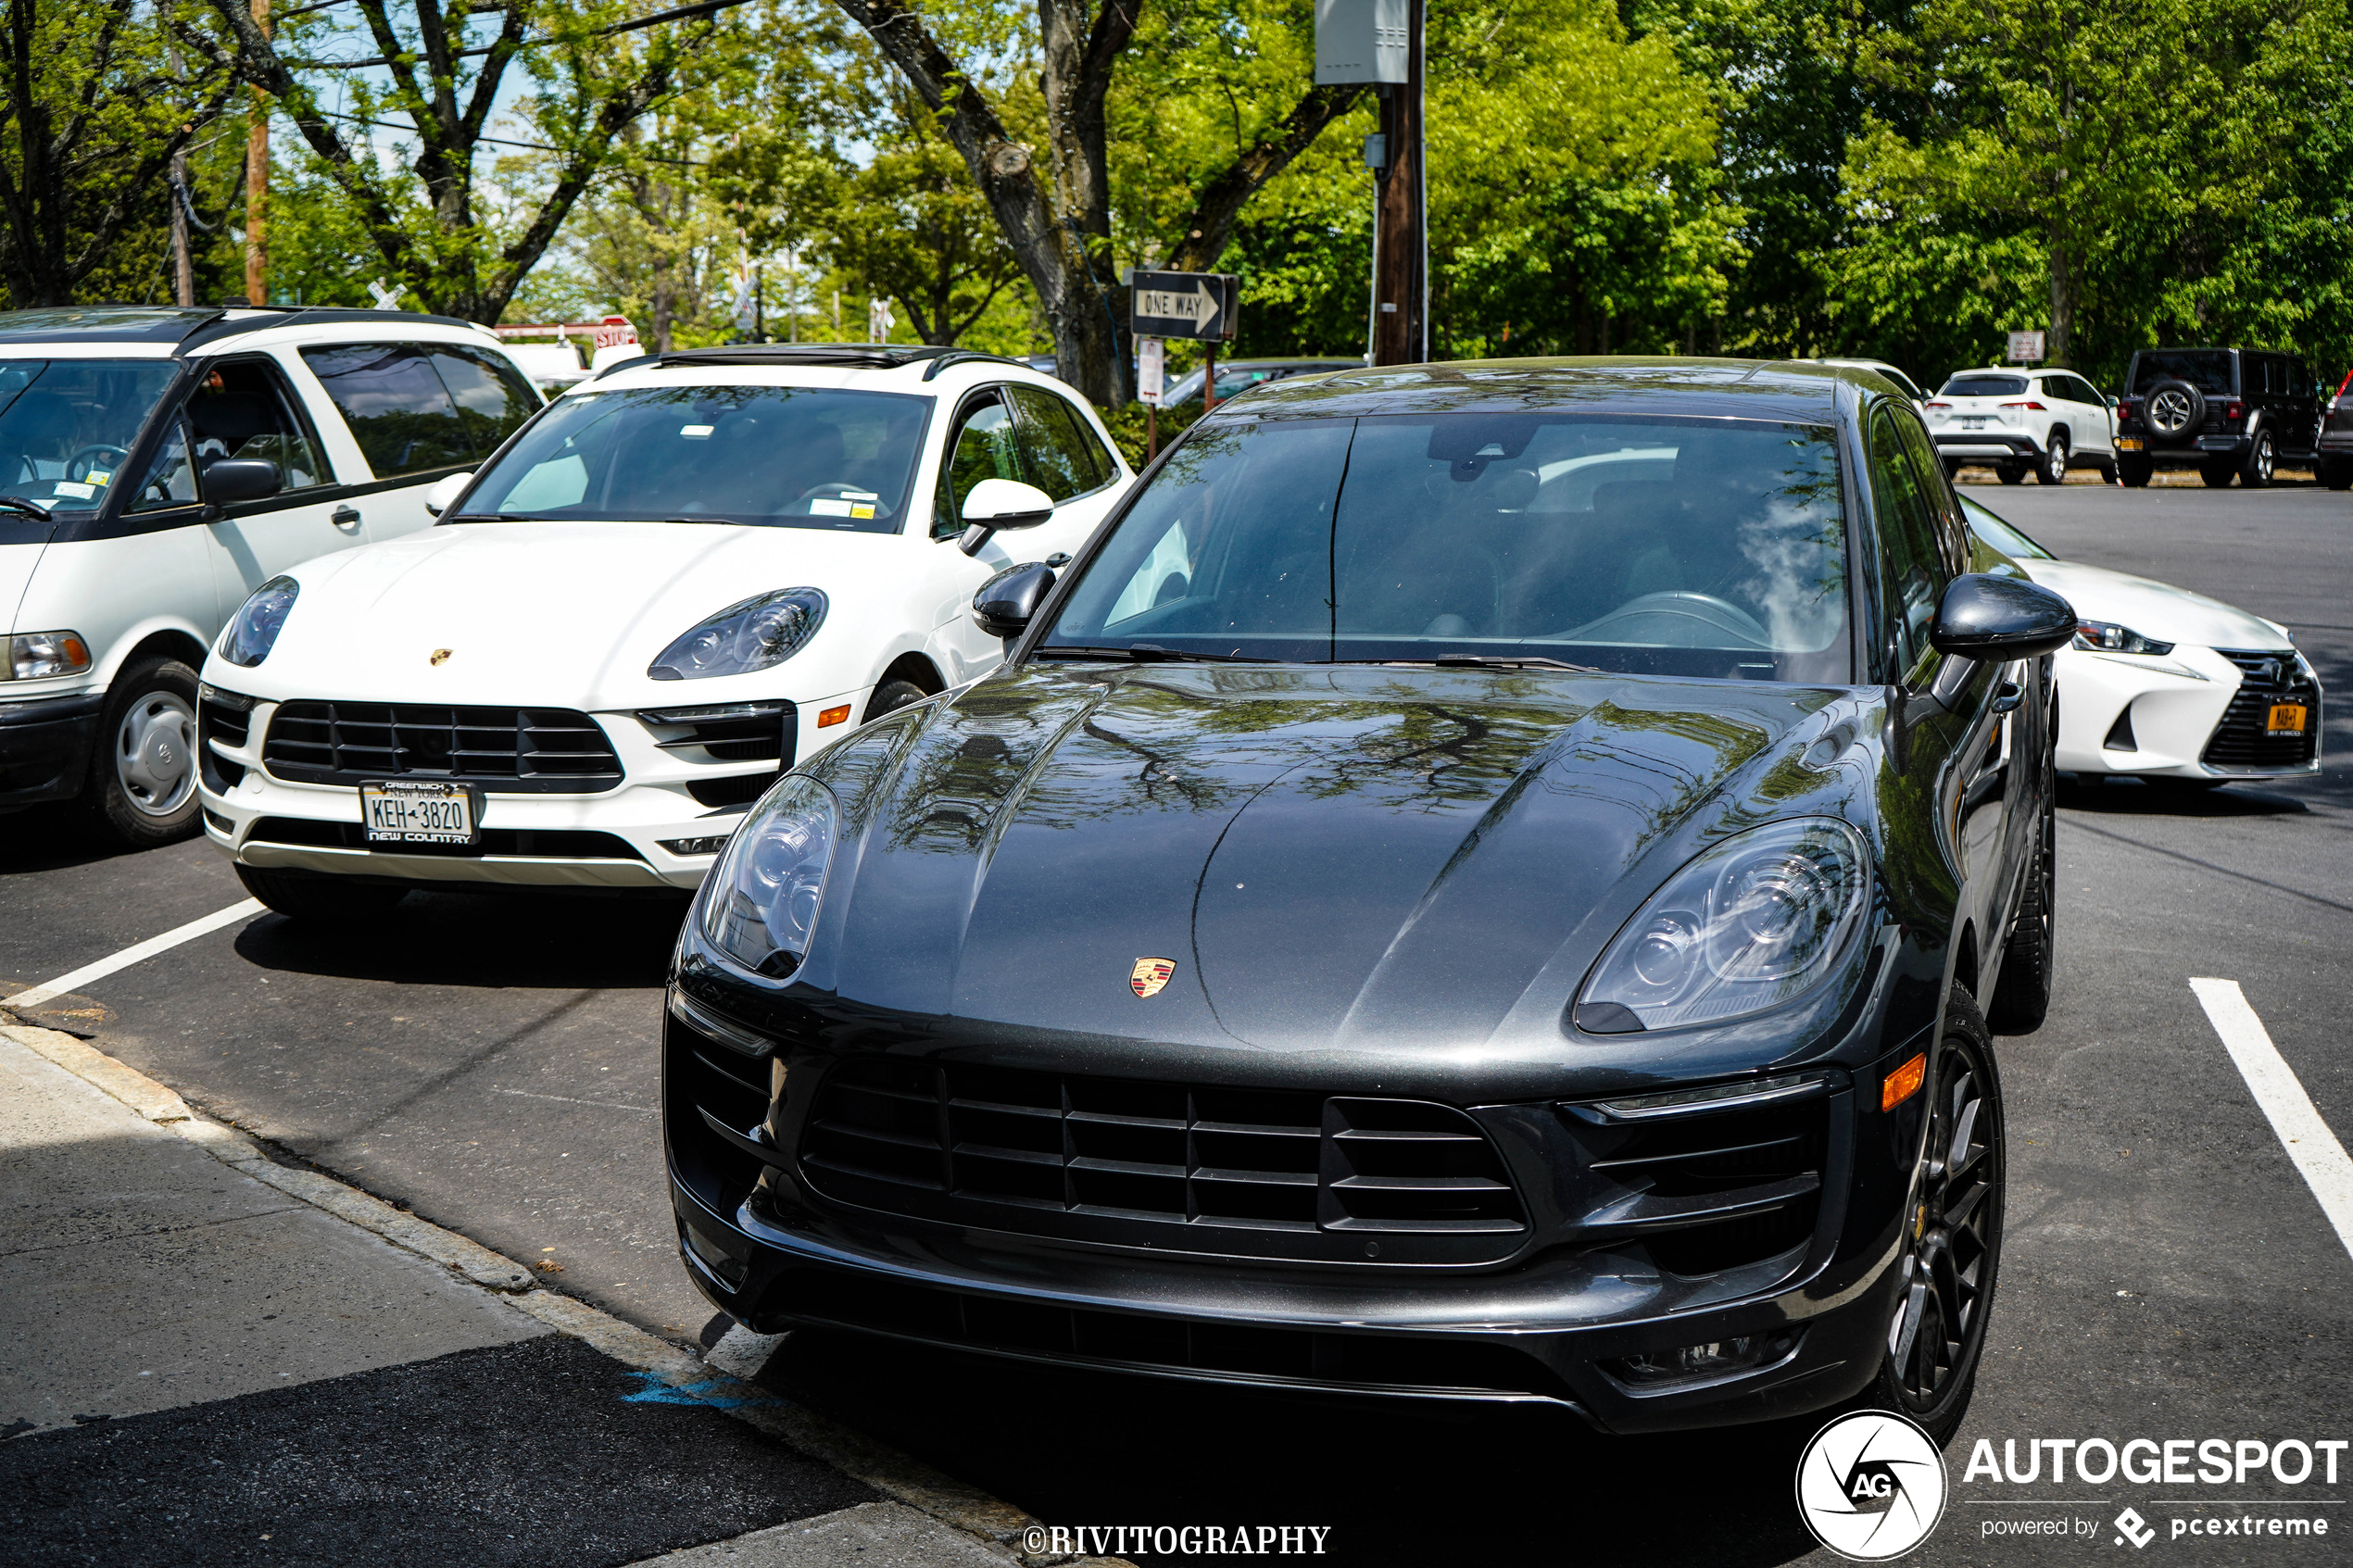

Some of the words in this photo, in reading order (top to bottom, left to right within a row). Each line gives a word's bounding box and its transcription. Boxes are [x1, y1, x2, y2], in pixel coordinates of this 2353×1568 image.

[1146, 295, 1169, 314] ONE
[1176, 296, 1202, 317] WAY
[384, 782, 445, 790] GREENWICH
[390, 788, 412, 797] NEW
[418, 789, 444, 799] YORK
[369, 832, 401, 841] NEW
[404, 833, 471, 844] COUNTRY
